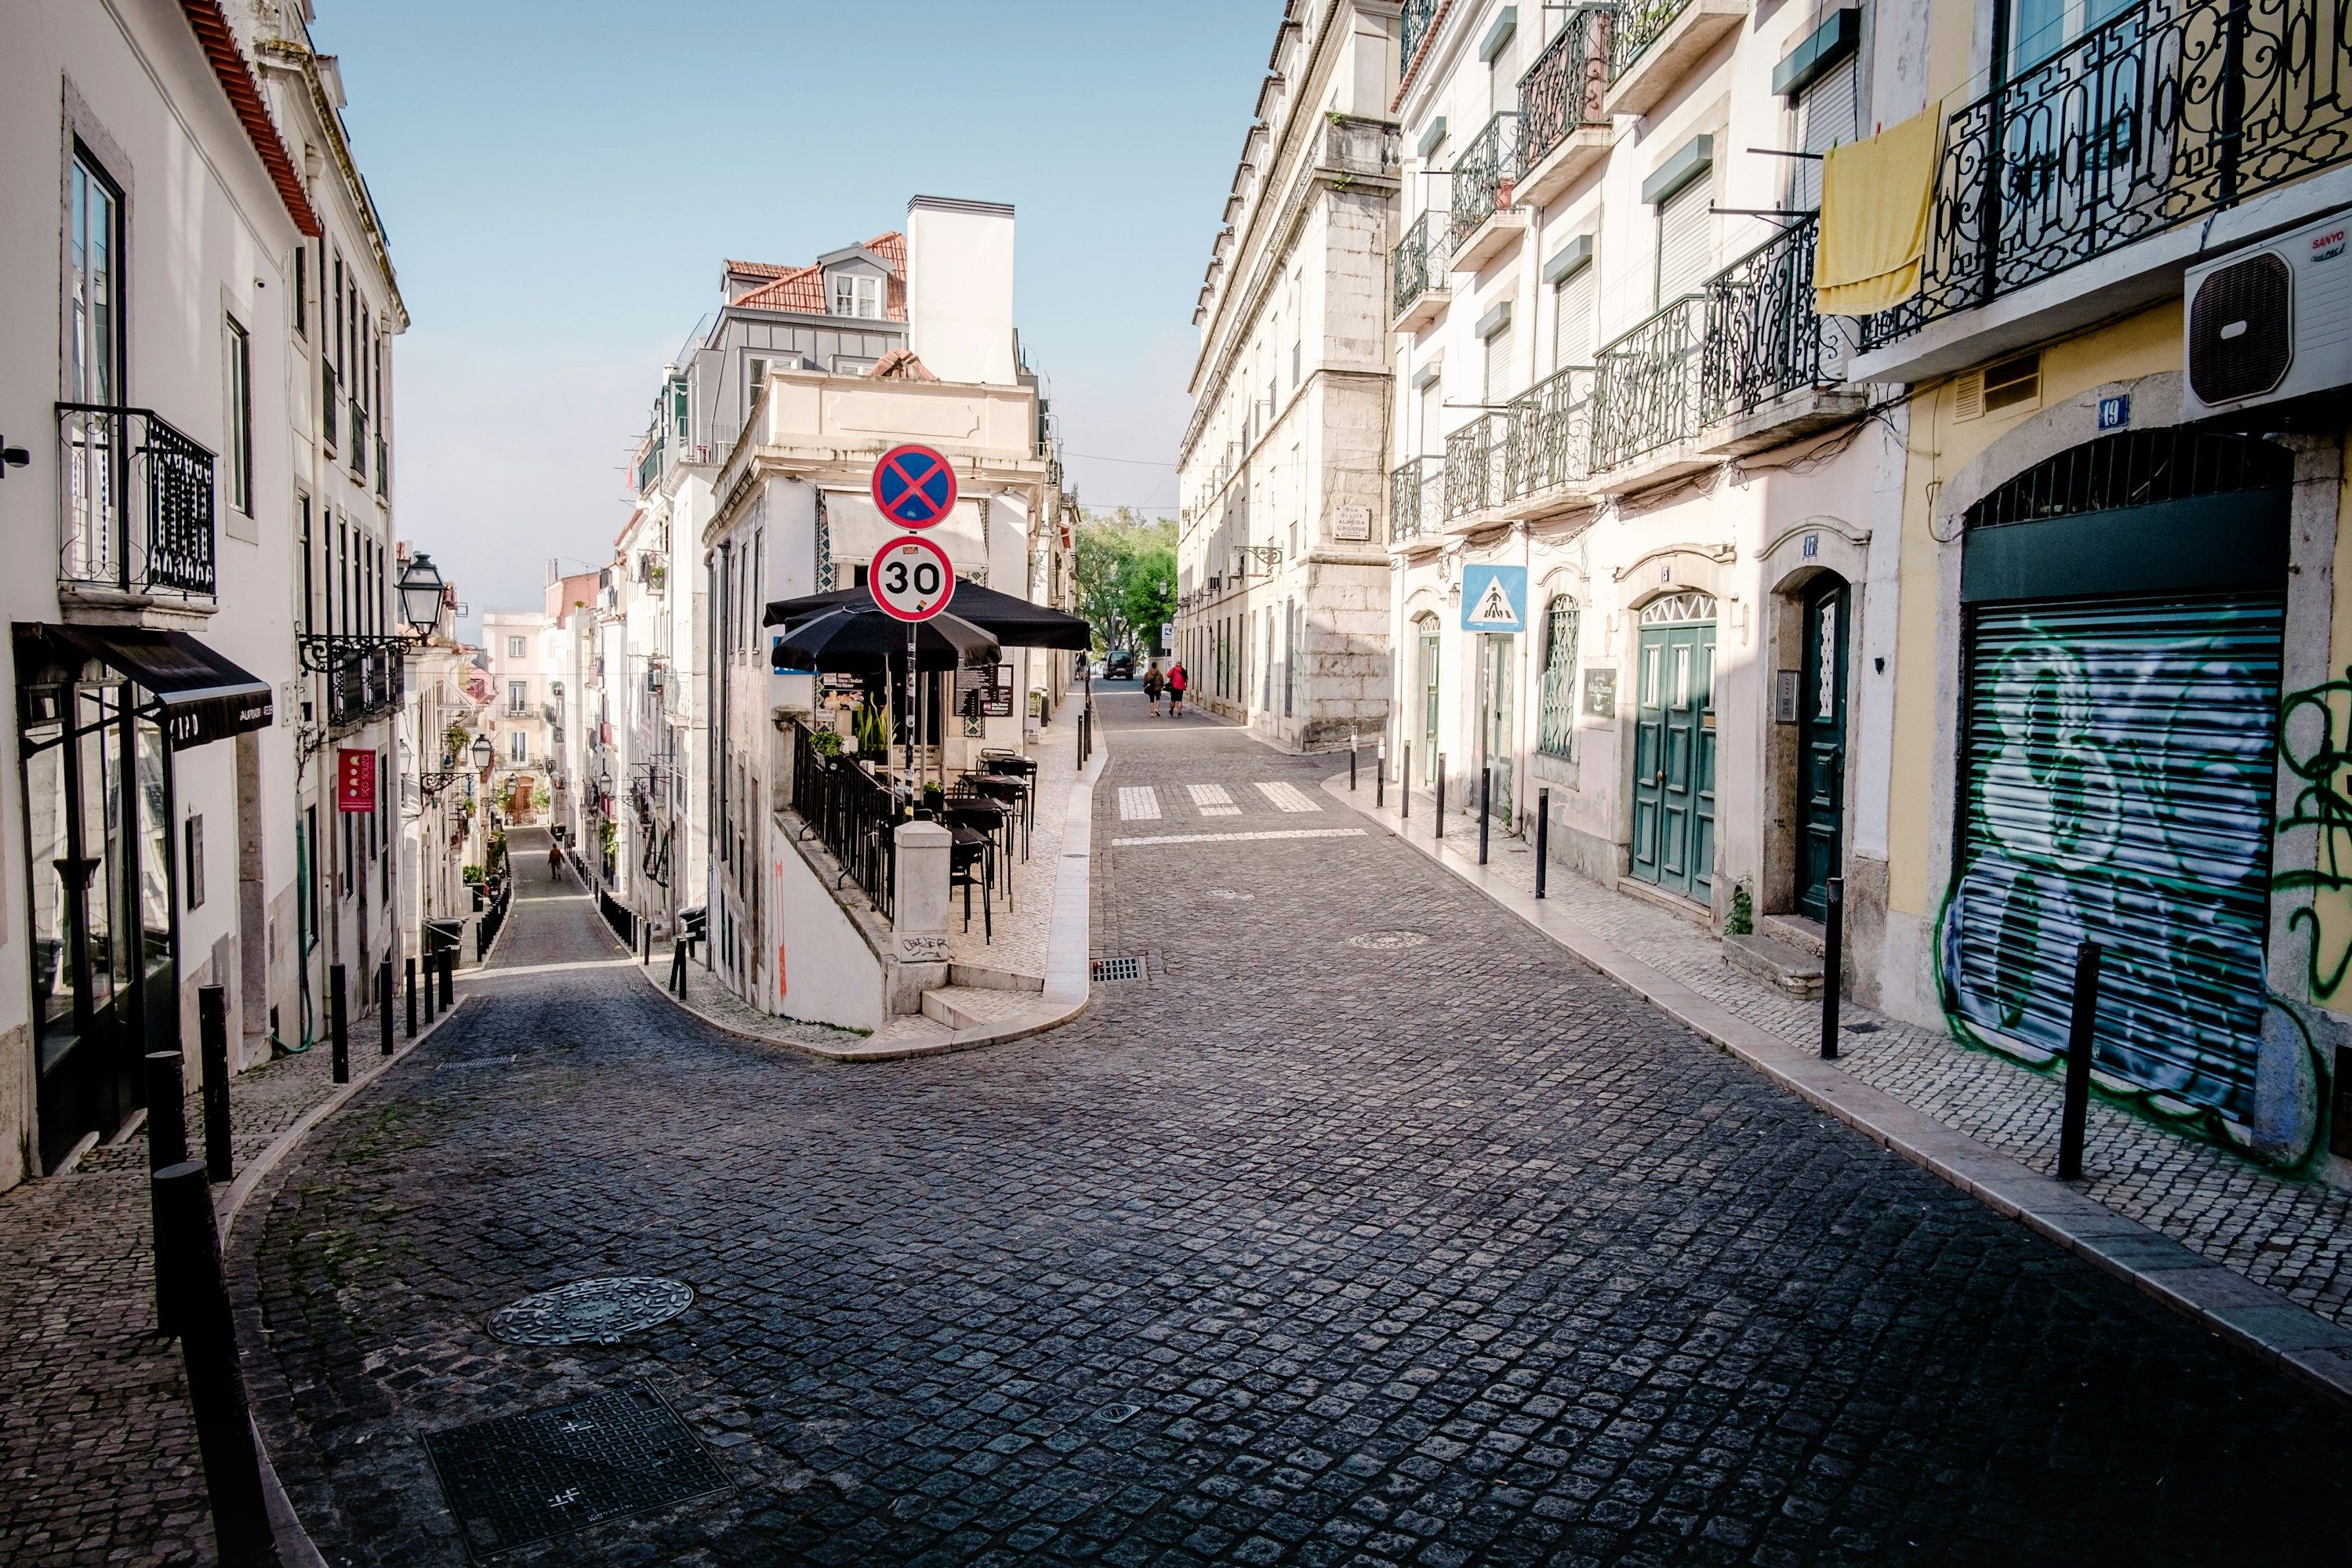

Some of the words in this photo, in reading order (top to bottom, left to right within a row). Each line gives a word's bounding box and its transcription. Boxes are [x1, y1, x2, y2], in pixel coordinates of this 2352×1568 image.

[2312, 230, 2344, 249] SANYO
[2104, 400, 2119, 426] 19
[885, 561, 939, 595] 30
